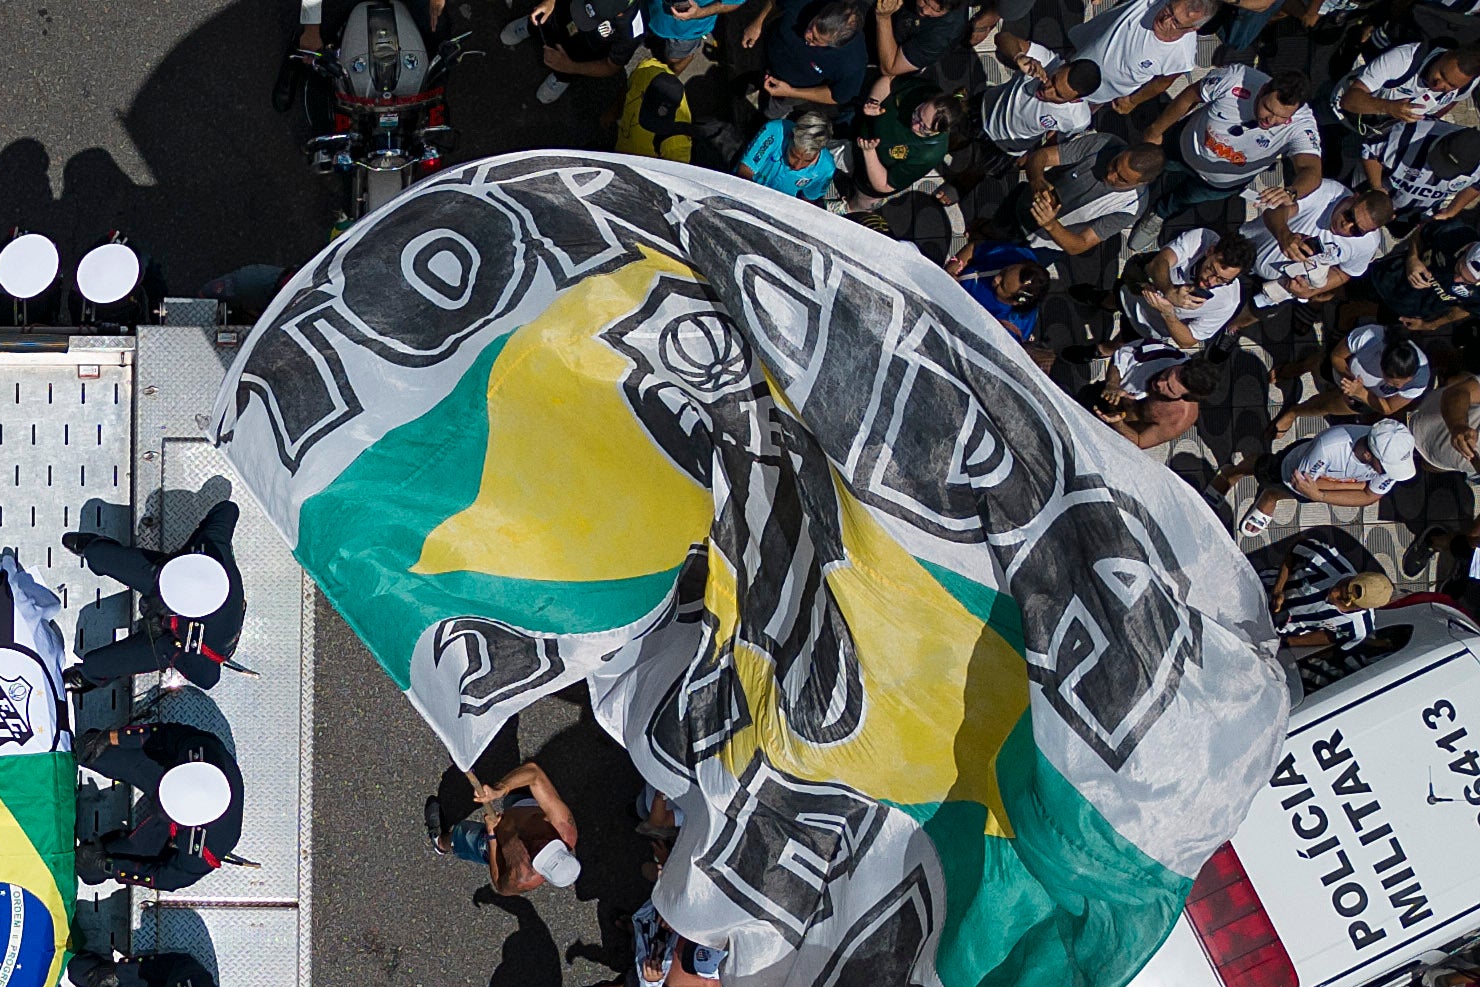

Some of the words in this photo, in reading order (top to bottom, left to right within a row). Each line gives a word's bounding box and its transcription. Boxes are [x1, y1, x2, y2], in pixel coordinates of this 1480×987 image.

[13, 891, 23, 928] ORDEM
[1270, 752, 1387, 950] POLÍCIA
[1312, 728, 1433, 929] MILITAR
